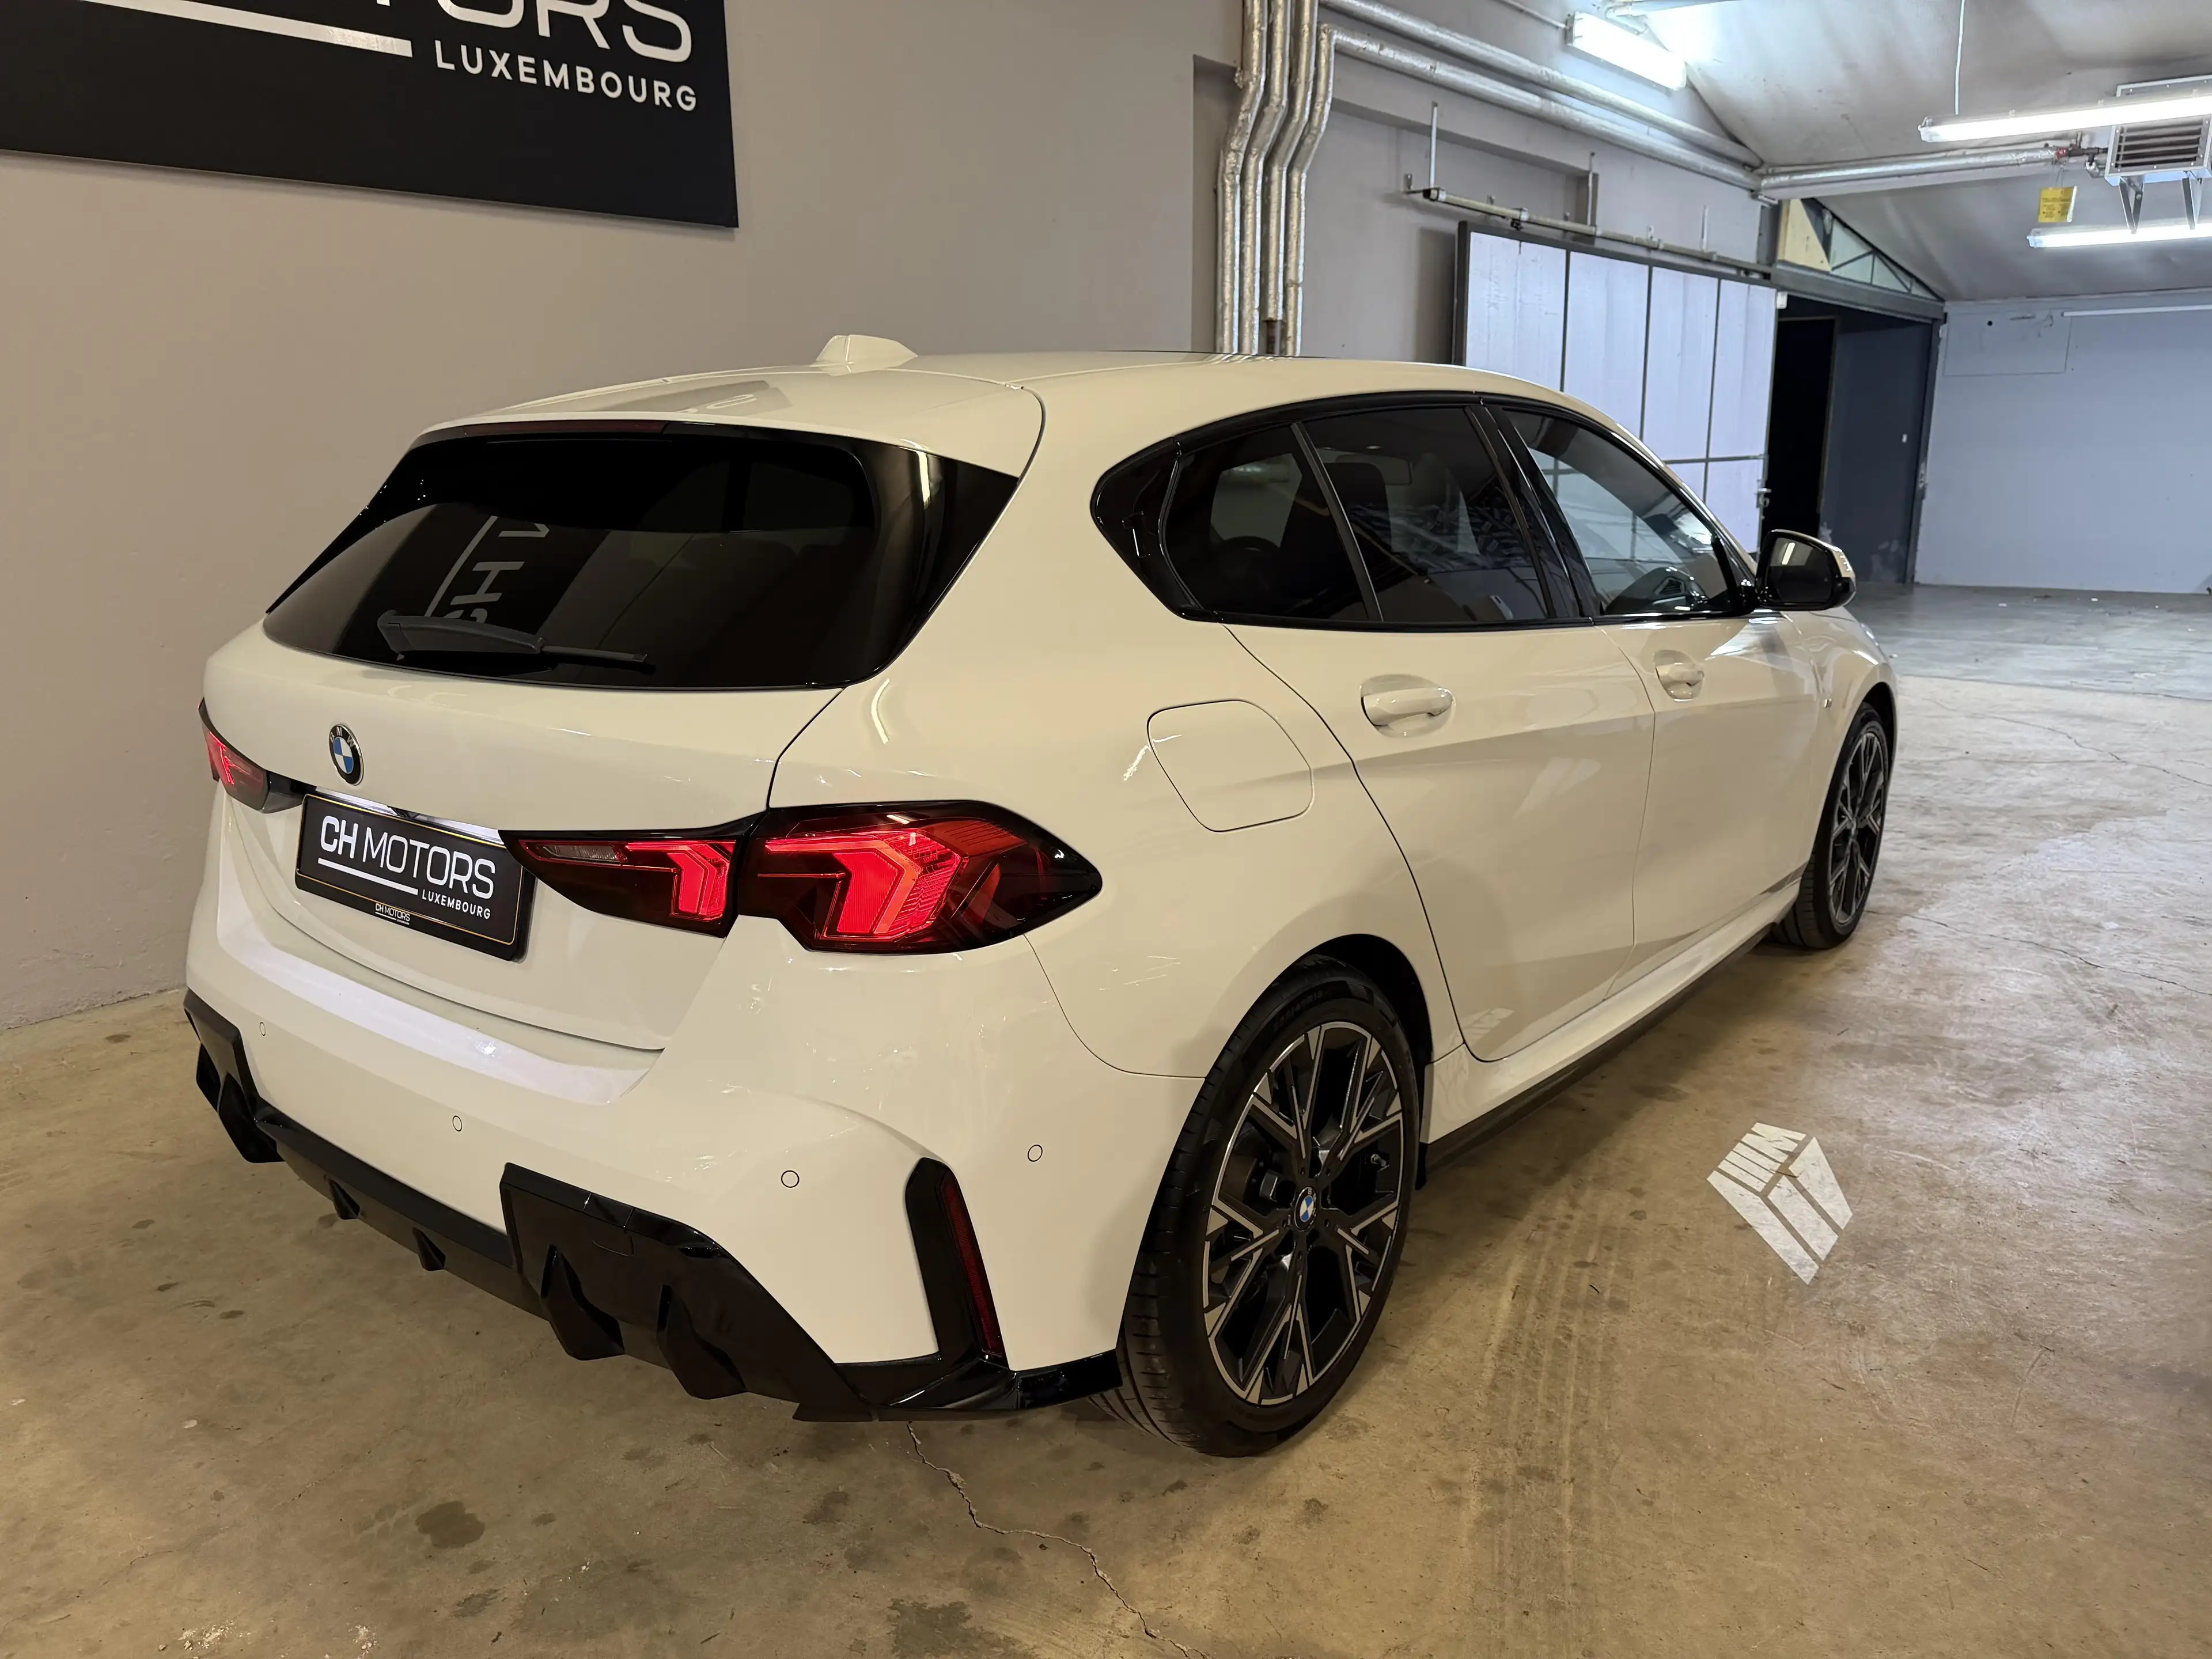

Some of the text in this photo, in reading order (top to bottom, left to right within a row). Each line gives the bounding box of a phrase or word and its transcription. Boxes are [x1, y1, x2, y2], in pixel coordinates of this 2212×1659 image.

[435, 40, 696, 112] LUXEMBOURG
[329, 726, 356, 748] BMW
[320, 815, 496, 899] CH MOTORS
[375, 903, 411, 922] CH MOTORS
[422, 889, 491, 920] LUXEMBOURG
